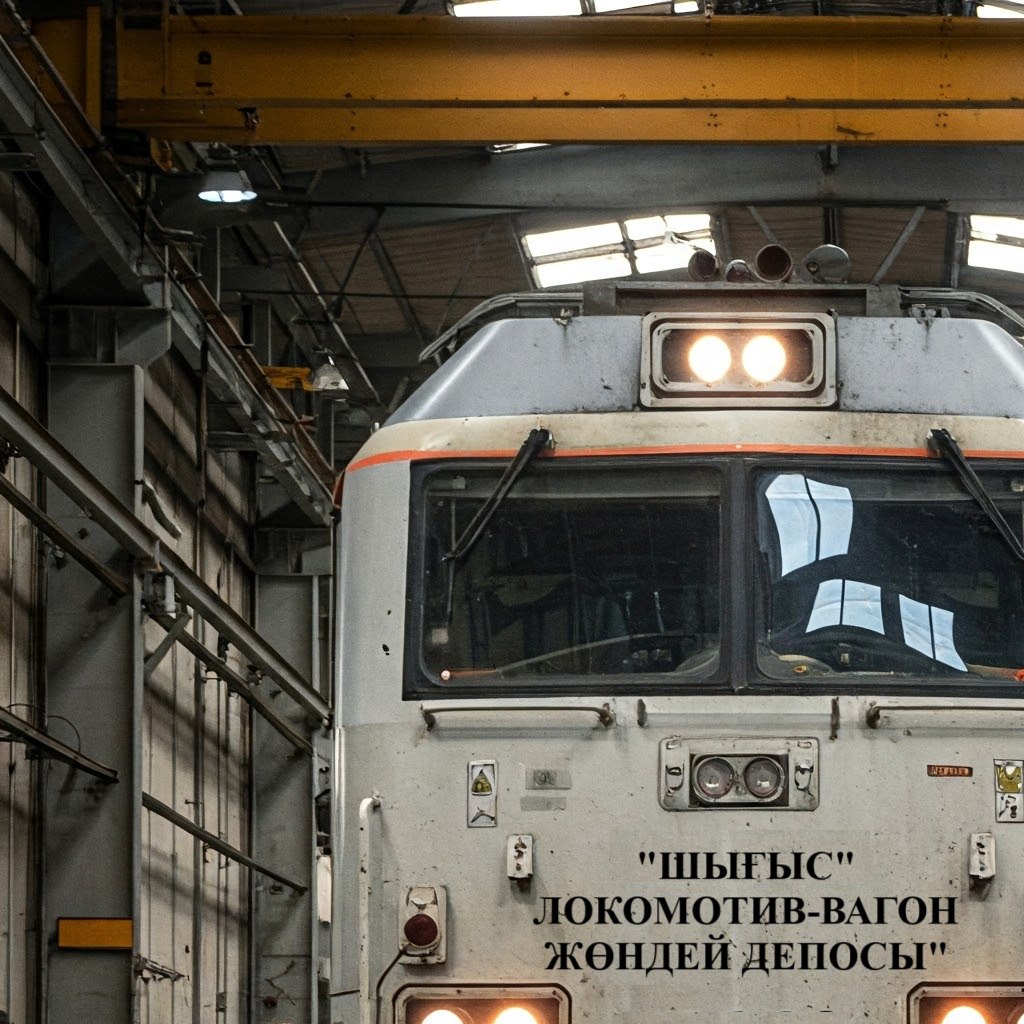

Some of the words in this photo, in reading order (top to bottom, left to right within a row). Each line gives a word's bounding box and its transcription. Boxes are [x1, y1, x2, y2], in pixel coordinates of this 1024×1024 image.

[639, 851, 853, 881] "ШЫҒЫС"
[532, 896, 959, 926] ЛОКОМОТИВ-ВАГОН
[544, 933, 732, 978] ЖӨНДЕЙ
[741, 941, 947, 977] ДЕПОСЫ"
